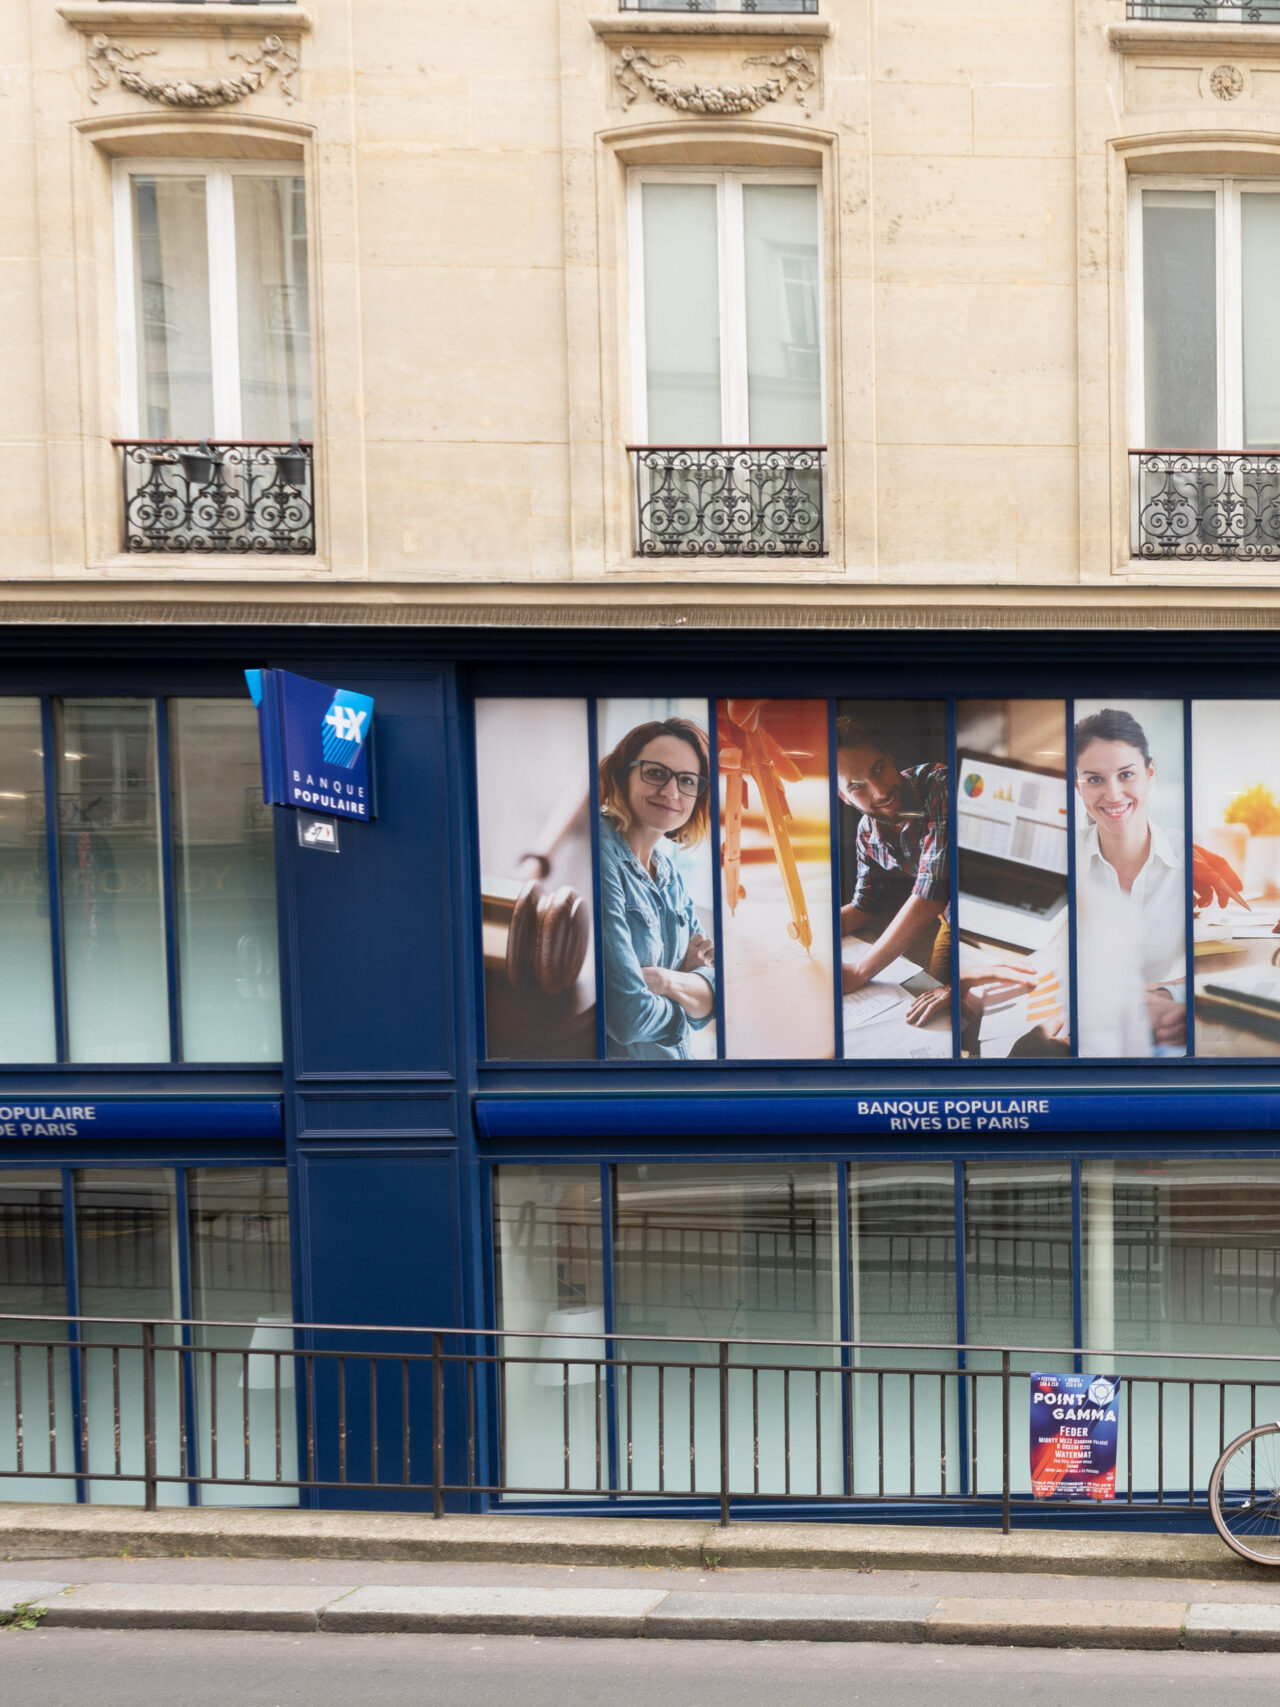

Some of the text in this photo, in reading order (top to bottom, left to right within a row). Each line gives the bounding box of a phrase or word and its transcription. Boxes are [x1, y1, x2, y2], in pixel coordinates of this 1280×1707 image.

[293, 770, 364, 798] BANQUE
[294, 788, 365, 814] POPULAIRE
[0, 1106, 96, 1120] OPULAIRE
[857, 1100, 1049, 1115] BANQUE POPULAIRE
[21, 1123, 78, 1136] PARIS
[890, 1116, 1030, 1130] RIVES DE PARIS
[1033, 1392, 1086, 1406] POINT
[1052, 1408, 1116, 1422] GAMMA
[1060, 1426, 1088, 1437] FEDER
[1055, 1450, 1092, 1458] WATERMAT
